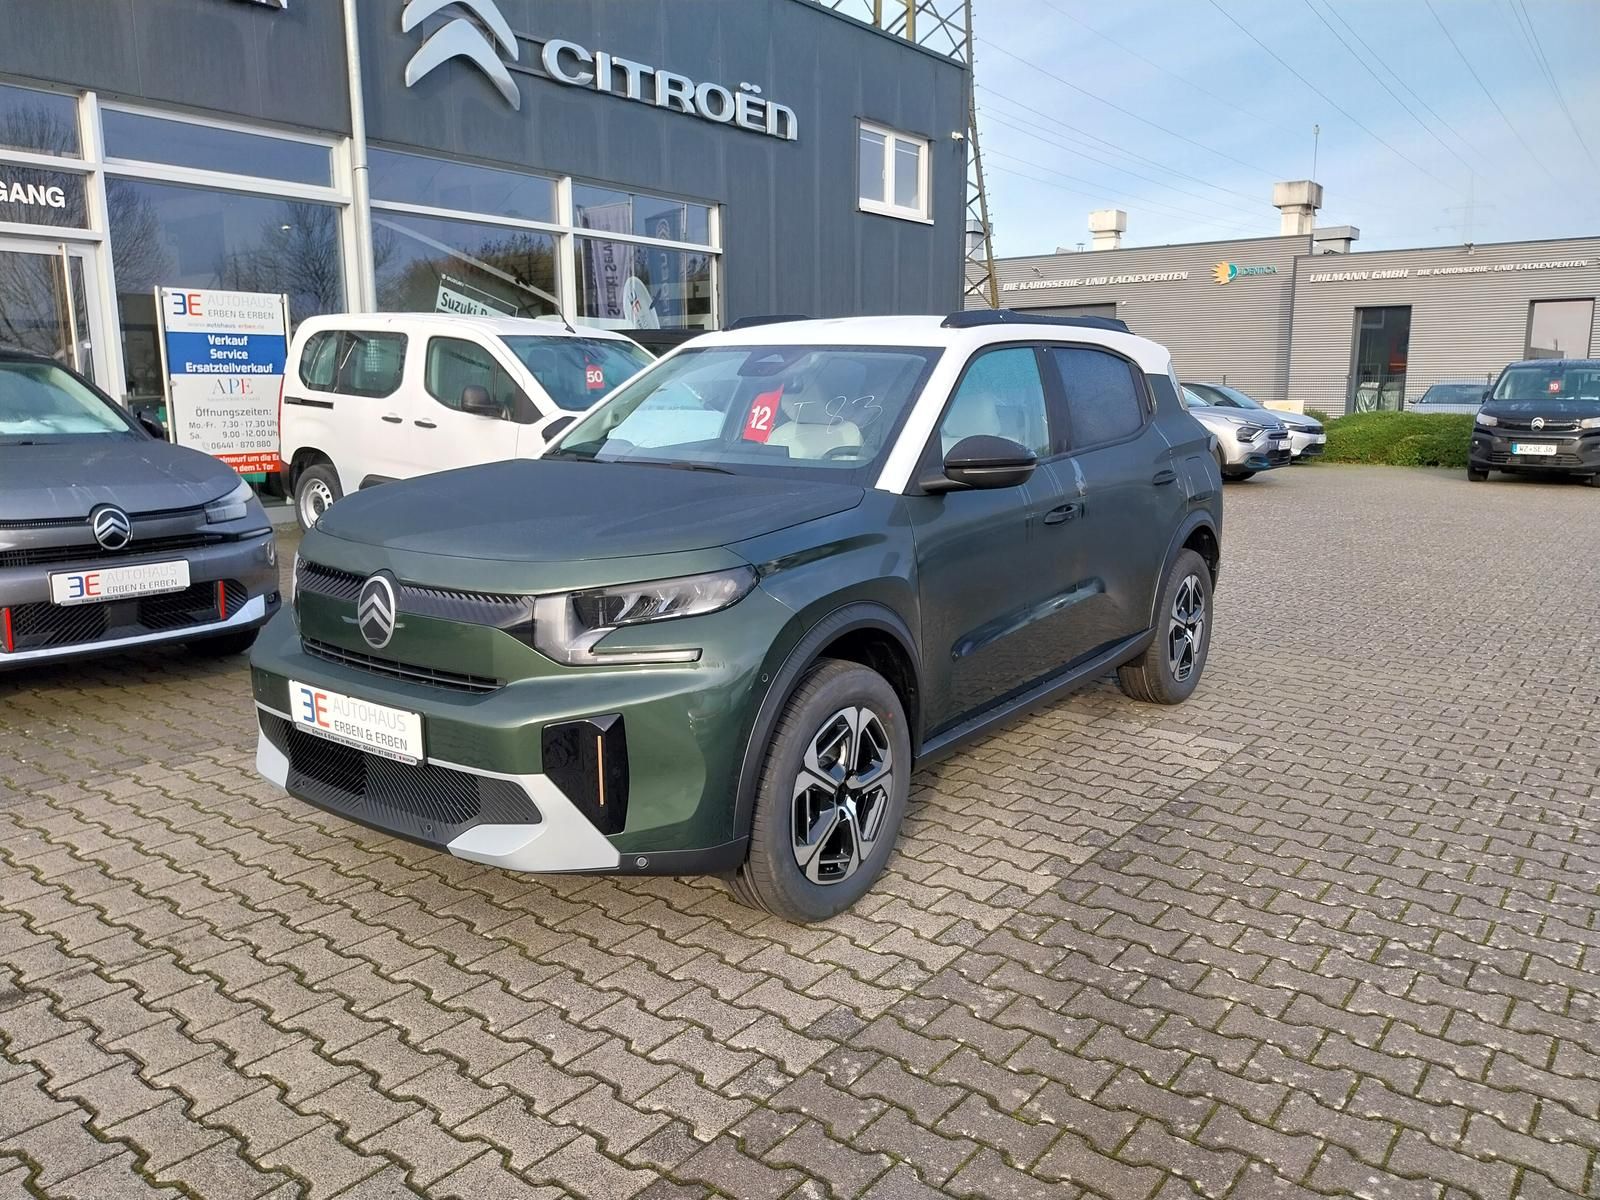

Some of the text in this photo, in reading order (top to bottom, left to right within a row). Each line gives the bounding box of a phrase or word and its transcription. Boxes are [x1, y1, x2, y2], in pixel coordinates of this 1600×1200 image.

[541, 39, 797, 141] CITROËN
[1417, 268, 1432, 276] DIE
[1494, 263, 1514, 272] UND
[1516, 260, 1587, 270] LACKEXPERTEN
[1003, 282, 1019, 291] DIE
[1085, 277, 1107, 286] UND
[1108, 271, 1189, 284] LACKEXPERTEN
[1310, 269, 1409, 283] UHLMANN GMBH
[208, 294, 273, 309] AUTOHAUS
[441, 292, 478, 315] Suzuki
[208, 309, 274, 320] ERBEN & ERBEN
[208, 334, 248, 346] Verkauf
[210, 349, 249, 360] Service
[186, 362, 273, 373] Ersatzteilverkauf
[586, 370, 603, 383] 50
[213, 378, 254, 395] APE
[195, 406, 272, 419] Öffnungszeiten:
[750, 405, 771, 431] 12
[222, 420, 239, 429] 7.30
[245, 420, 265, 428] 17.30
[245, 429, 266, 437] 12.00
[256, 440, 271, 448] 880
[260, 454, 272, 462] die
[239, 464, 255, 472] dem
[106, 565, 177, 584] AUTOHAUS
[106, 583, 137, 594] ERBEN
[139, 582, 146, 591] &
[148, 578, 178, 589] ERBEN
[333, 697, 407, 732] AUTOHAUS
[334, 720, 408, 751] ERBEN & ERBEN
